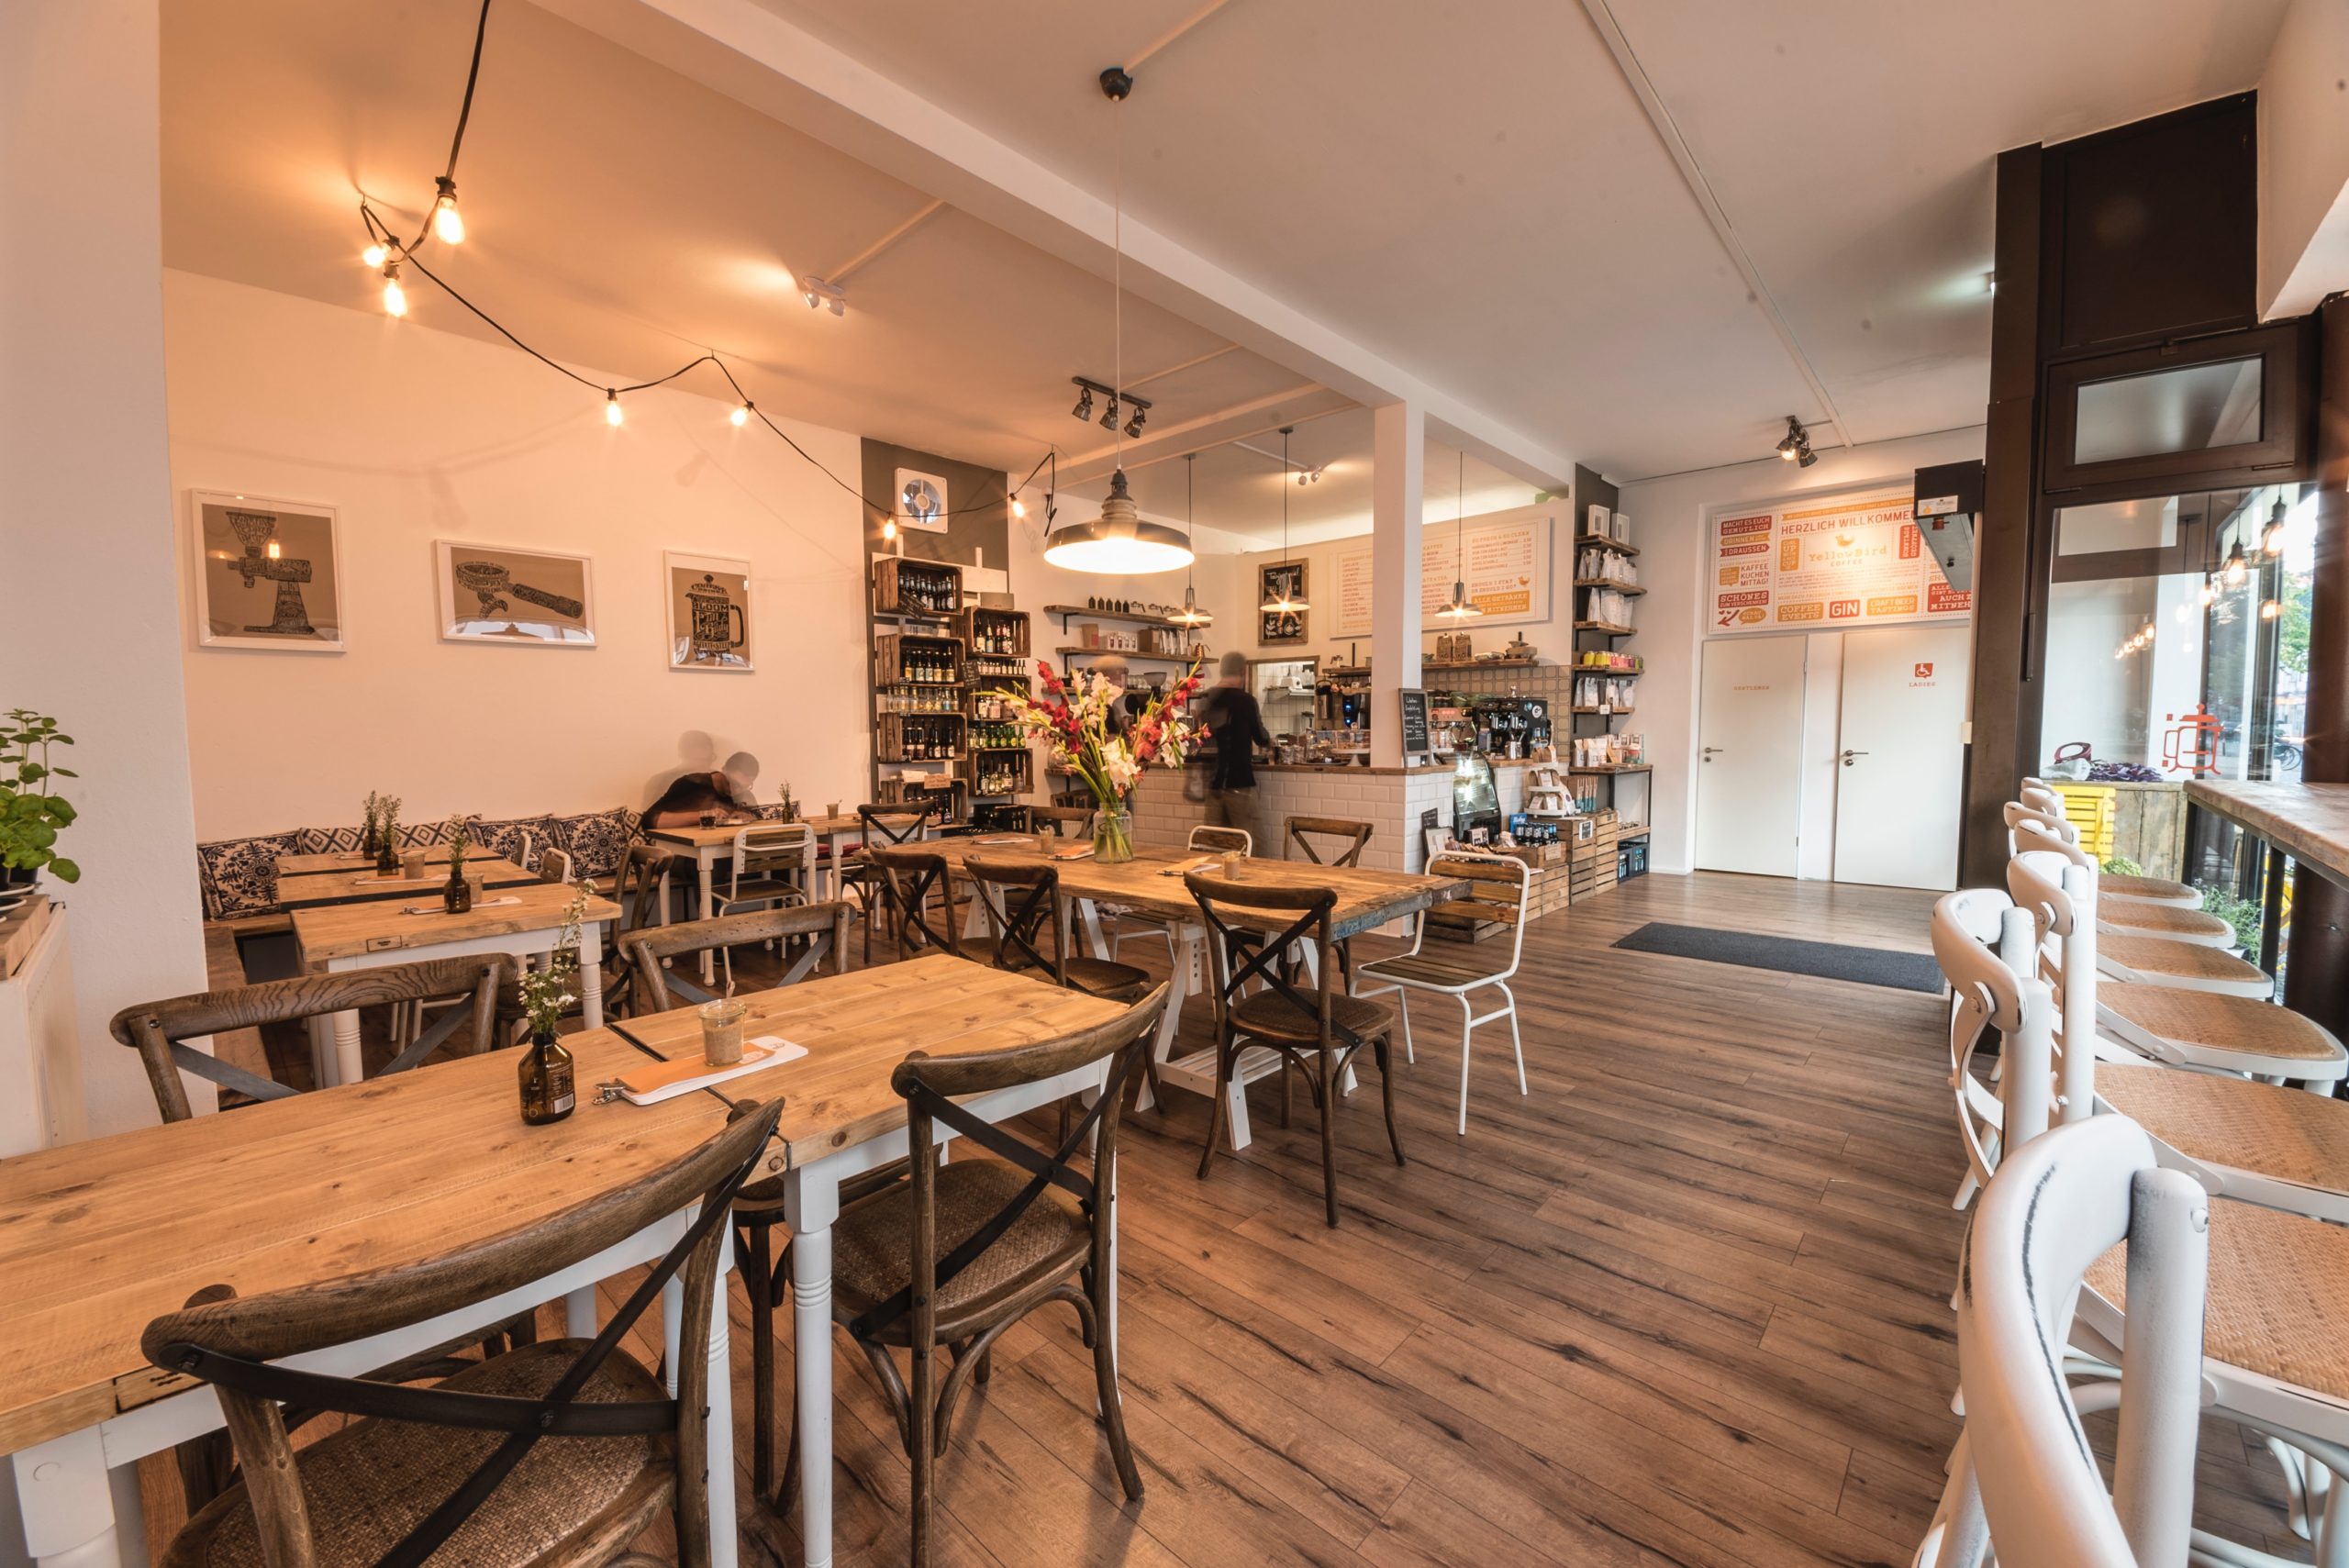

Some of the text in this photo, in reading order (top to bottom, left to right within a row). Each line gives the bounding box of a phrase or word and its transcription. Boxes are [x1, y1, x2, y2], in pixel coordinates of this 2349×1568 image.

[1781, 520, 1835, 535] HERZLICH
[1729, 545, 1766, 554] DRAUSSEN
[1741, 562, 1769, 572] KAFFEE
[1831, 559, 1863, 567] COFFEE
[1741, 571, 1769, 579] KUCHEN
[1741, 578, 1769, 587] MITTAG!
[1940, 594, 1962, 603] AUCH
[693, 602, 729, 612] BLOOM
[1780, 603, 1820, 614] COFFEE
[1831, 602, 1858, 616] GIN
[1931, 601, 1972, 611] MITNEH
[1782, 611, 1819, 621] EVENTS
